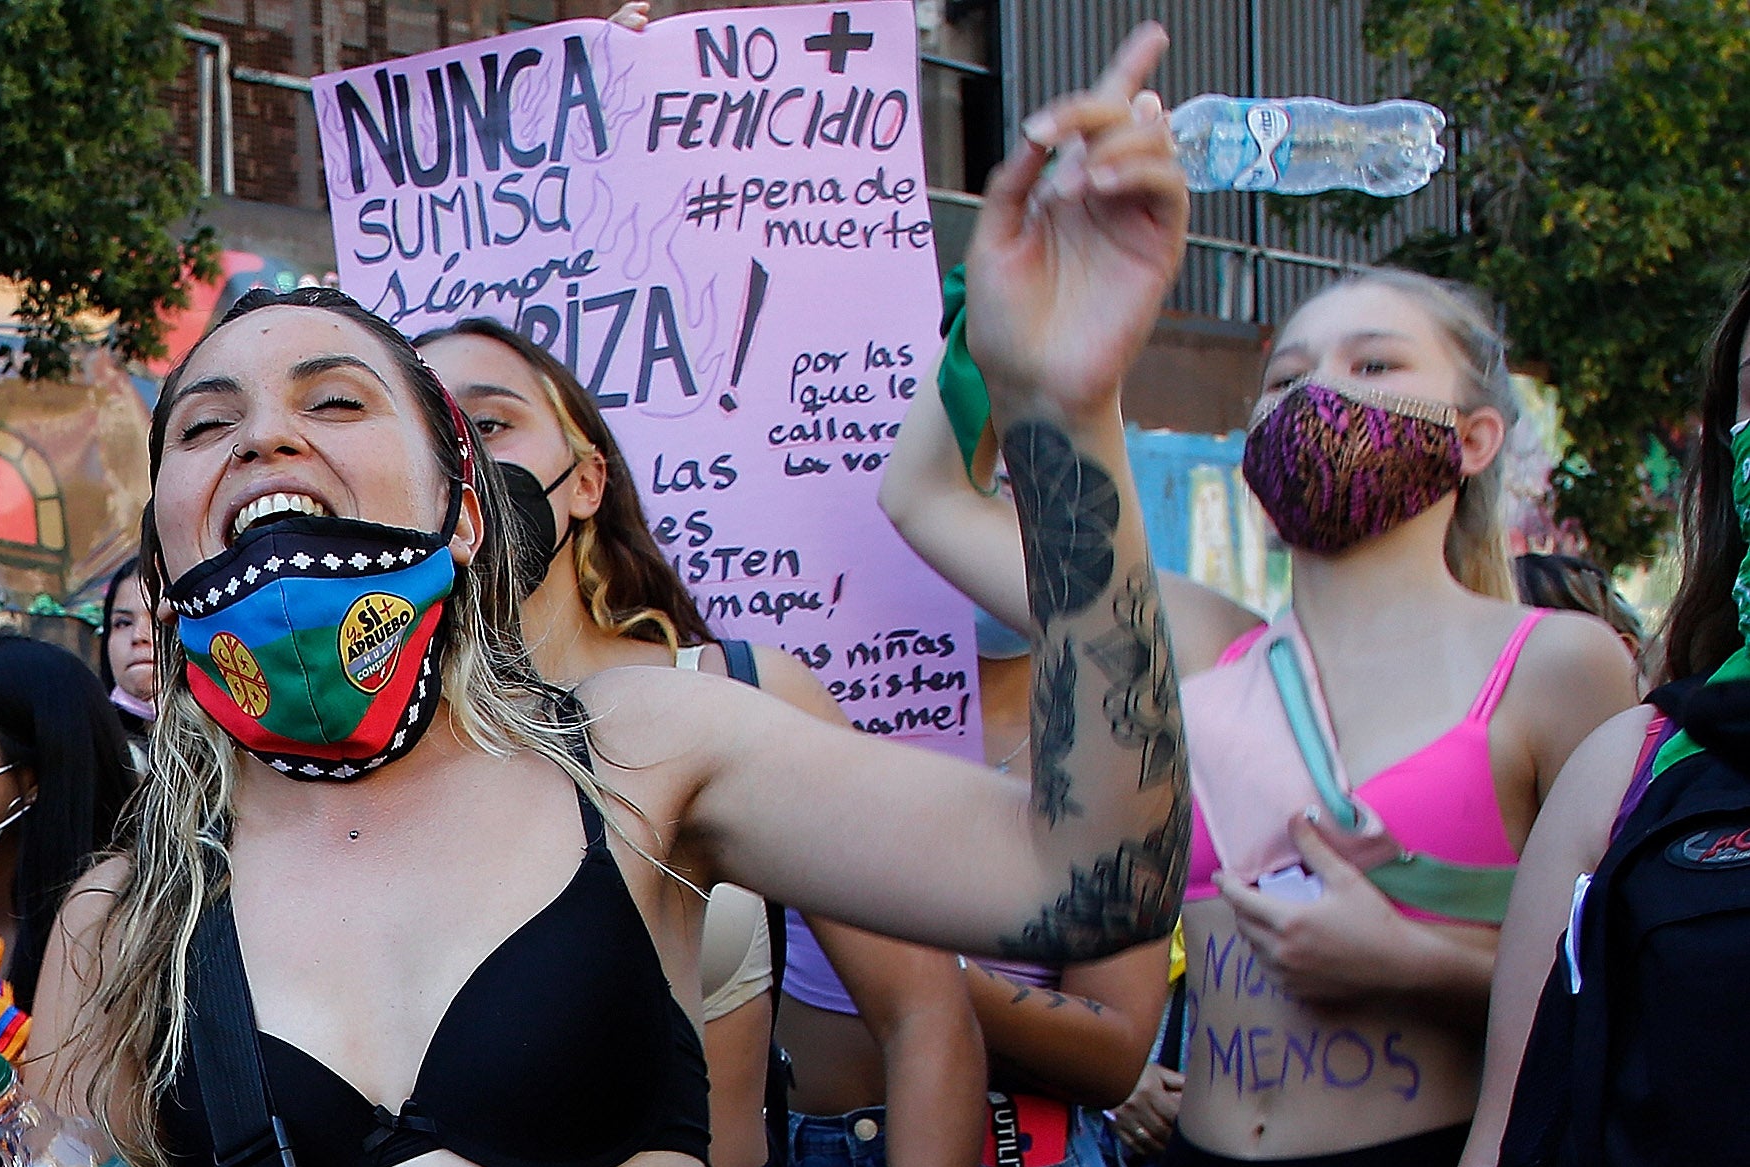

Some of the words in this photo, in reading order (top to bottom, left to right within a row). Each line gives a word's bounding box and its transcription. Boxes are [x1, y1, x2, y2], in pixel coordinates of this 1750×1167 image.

[696, 24, 778, 82] NO
[335, 35, 608, 194] NUNCA
[764, 209, 933, 249] muerte
[369, 249, 600, 332] siempre
[790, 351, 849, 403] por
[864, 340, 914, 373] las
[800, 384, 876, 416] que
[888, 373, 917, 400] le
[842, 452, 891, 472] vo
[347, 610, 411, 663] APRUEBO
[780, 643, 832, 669] as
[846, 628, 956, 669] niñas
[827, 664, 966, 703] esisten
[1206, 1024, 1421, 1102] MENOS
